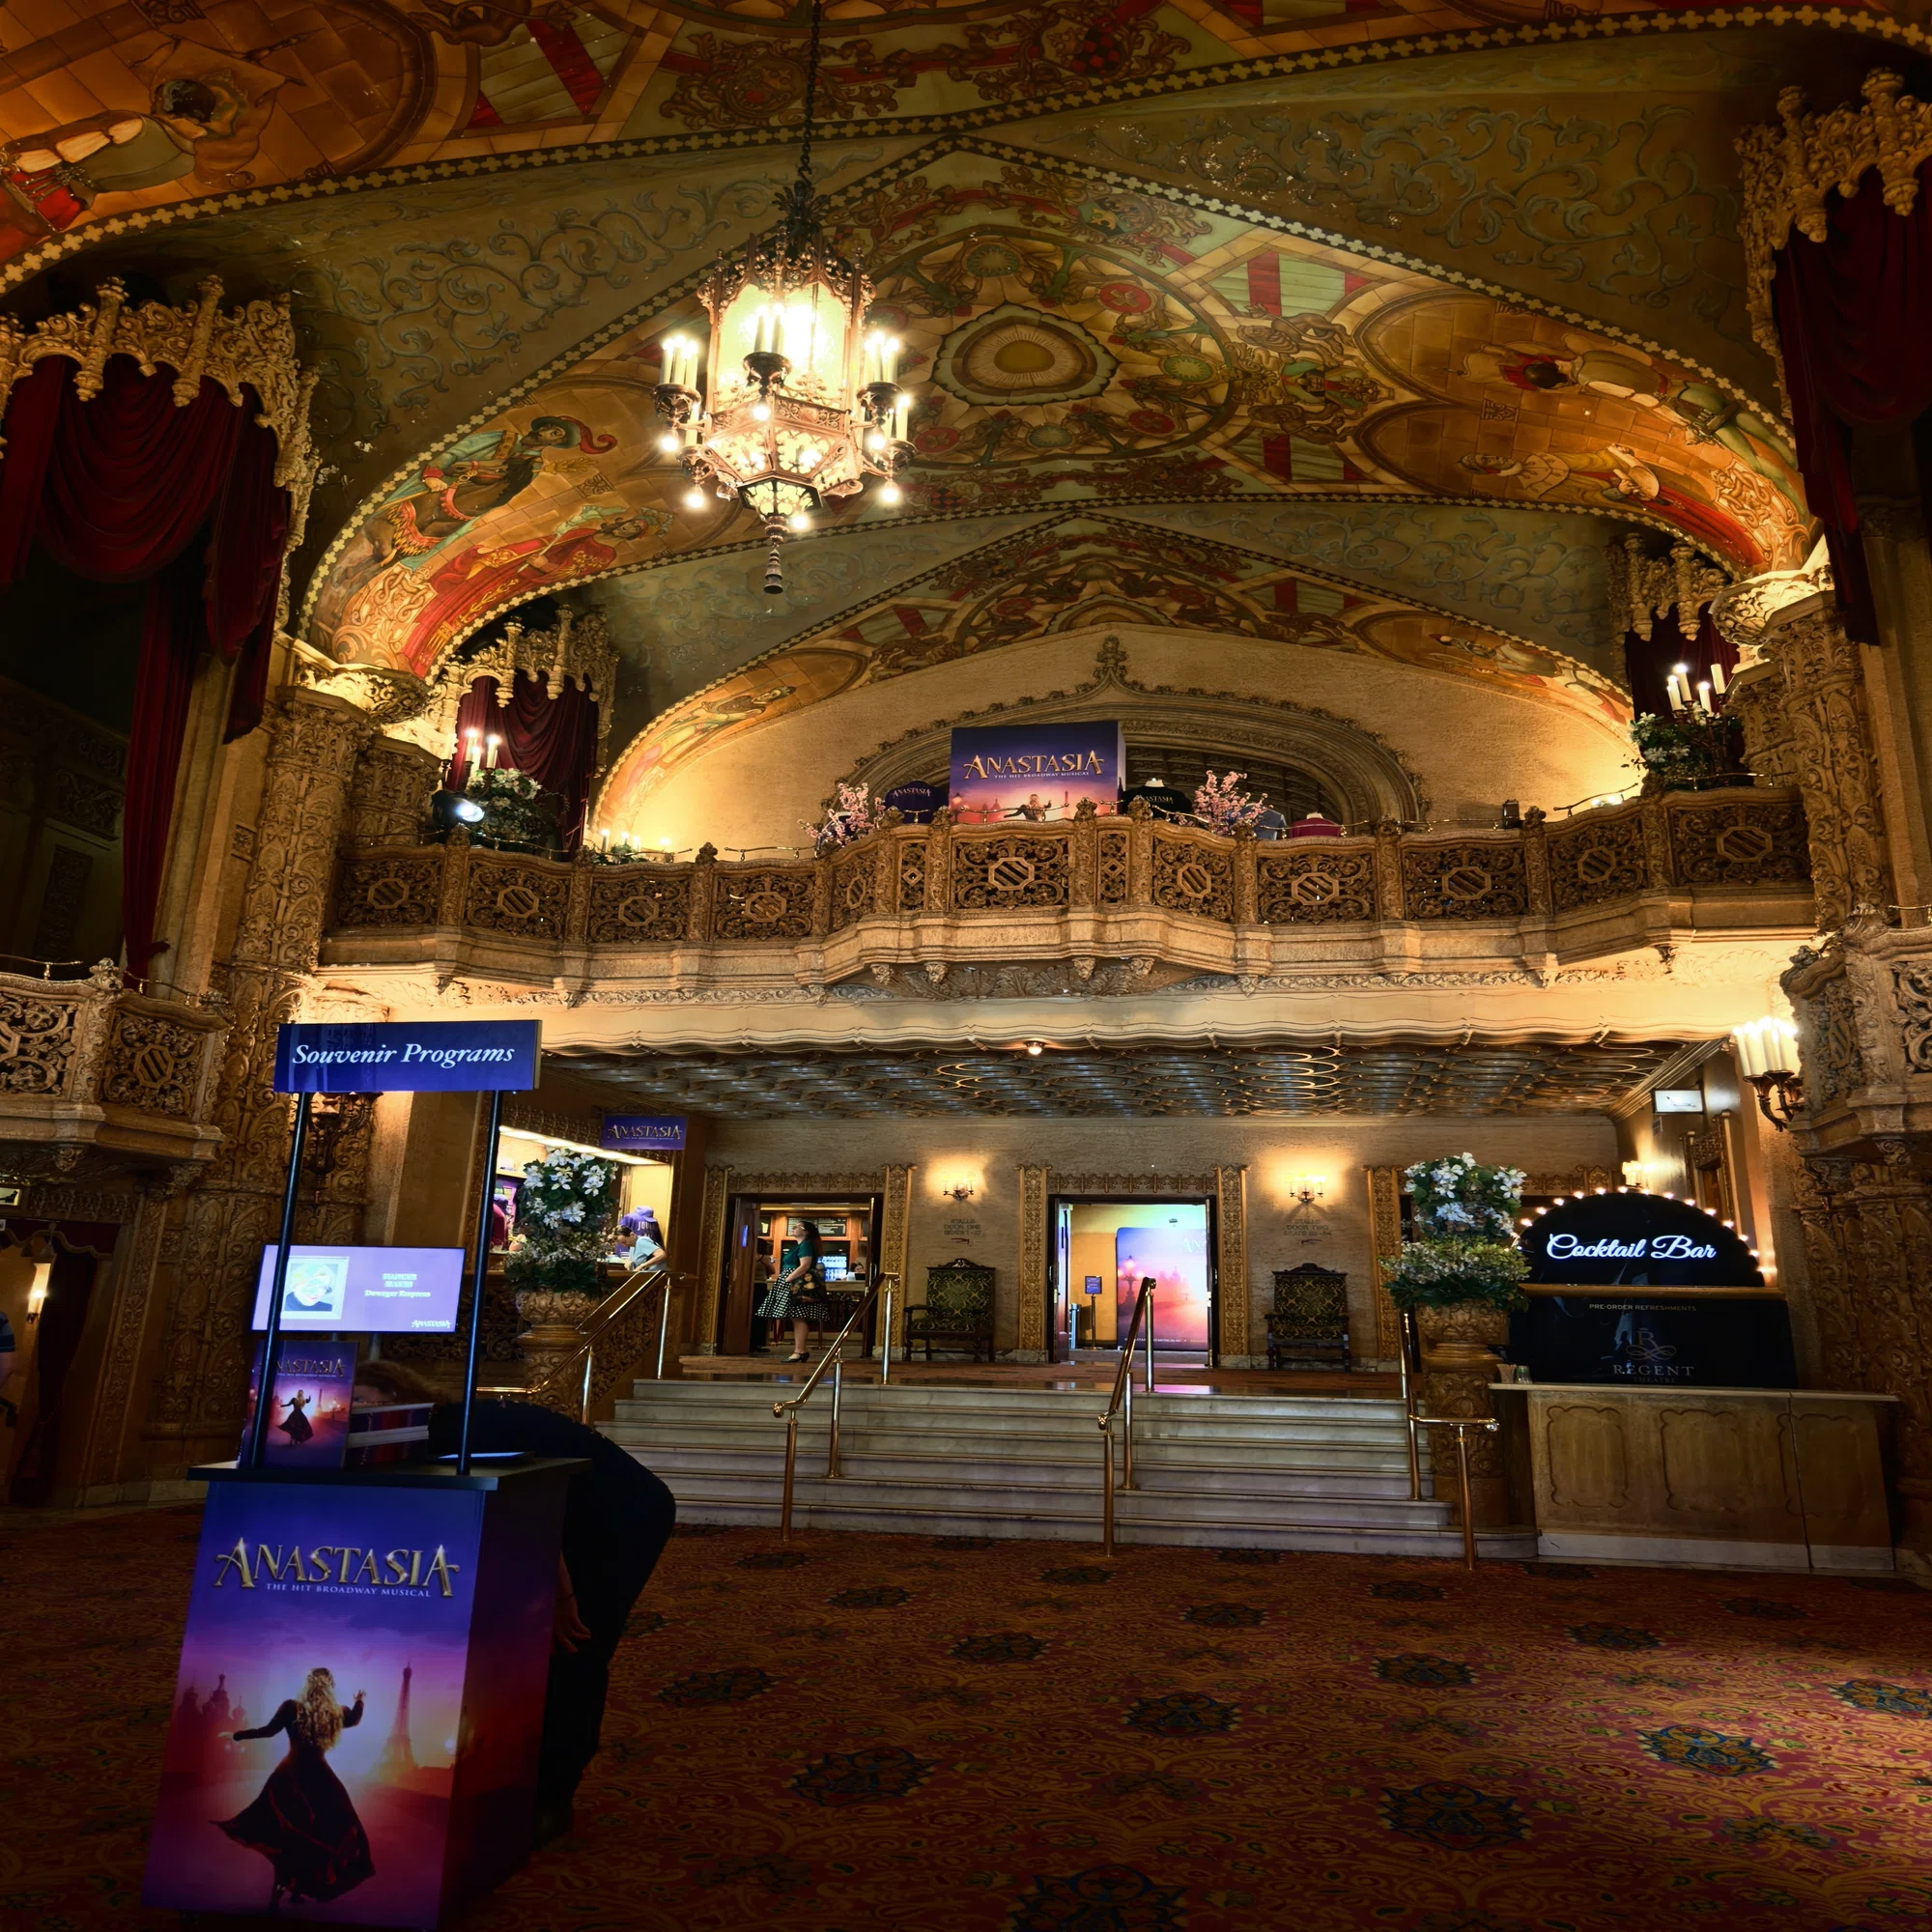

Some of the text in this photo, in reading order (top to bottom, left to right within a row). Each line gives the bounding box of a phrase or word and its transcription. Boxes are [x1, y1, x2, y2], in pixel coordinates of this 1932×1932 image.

[963, 750, 1105, 780] ANASTASIA
[892, 787, 932, 799] ANASTASIA
[292, 1042, 515, 1069] Souvenir Programs
[607, 1124, 683, 1140] ANASTASIA
[1546, 1233, 1718, 1260] Cocktail Bar
[412, 1320, 451, 1328] ANASTASIA
[1612, 1364, 1694, 1377] REGENT
[213, 1536, 460, 1597] ANASTASIA
[267, 1582, 431, 1598] THE HIT BROADWAY MUSICAL
